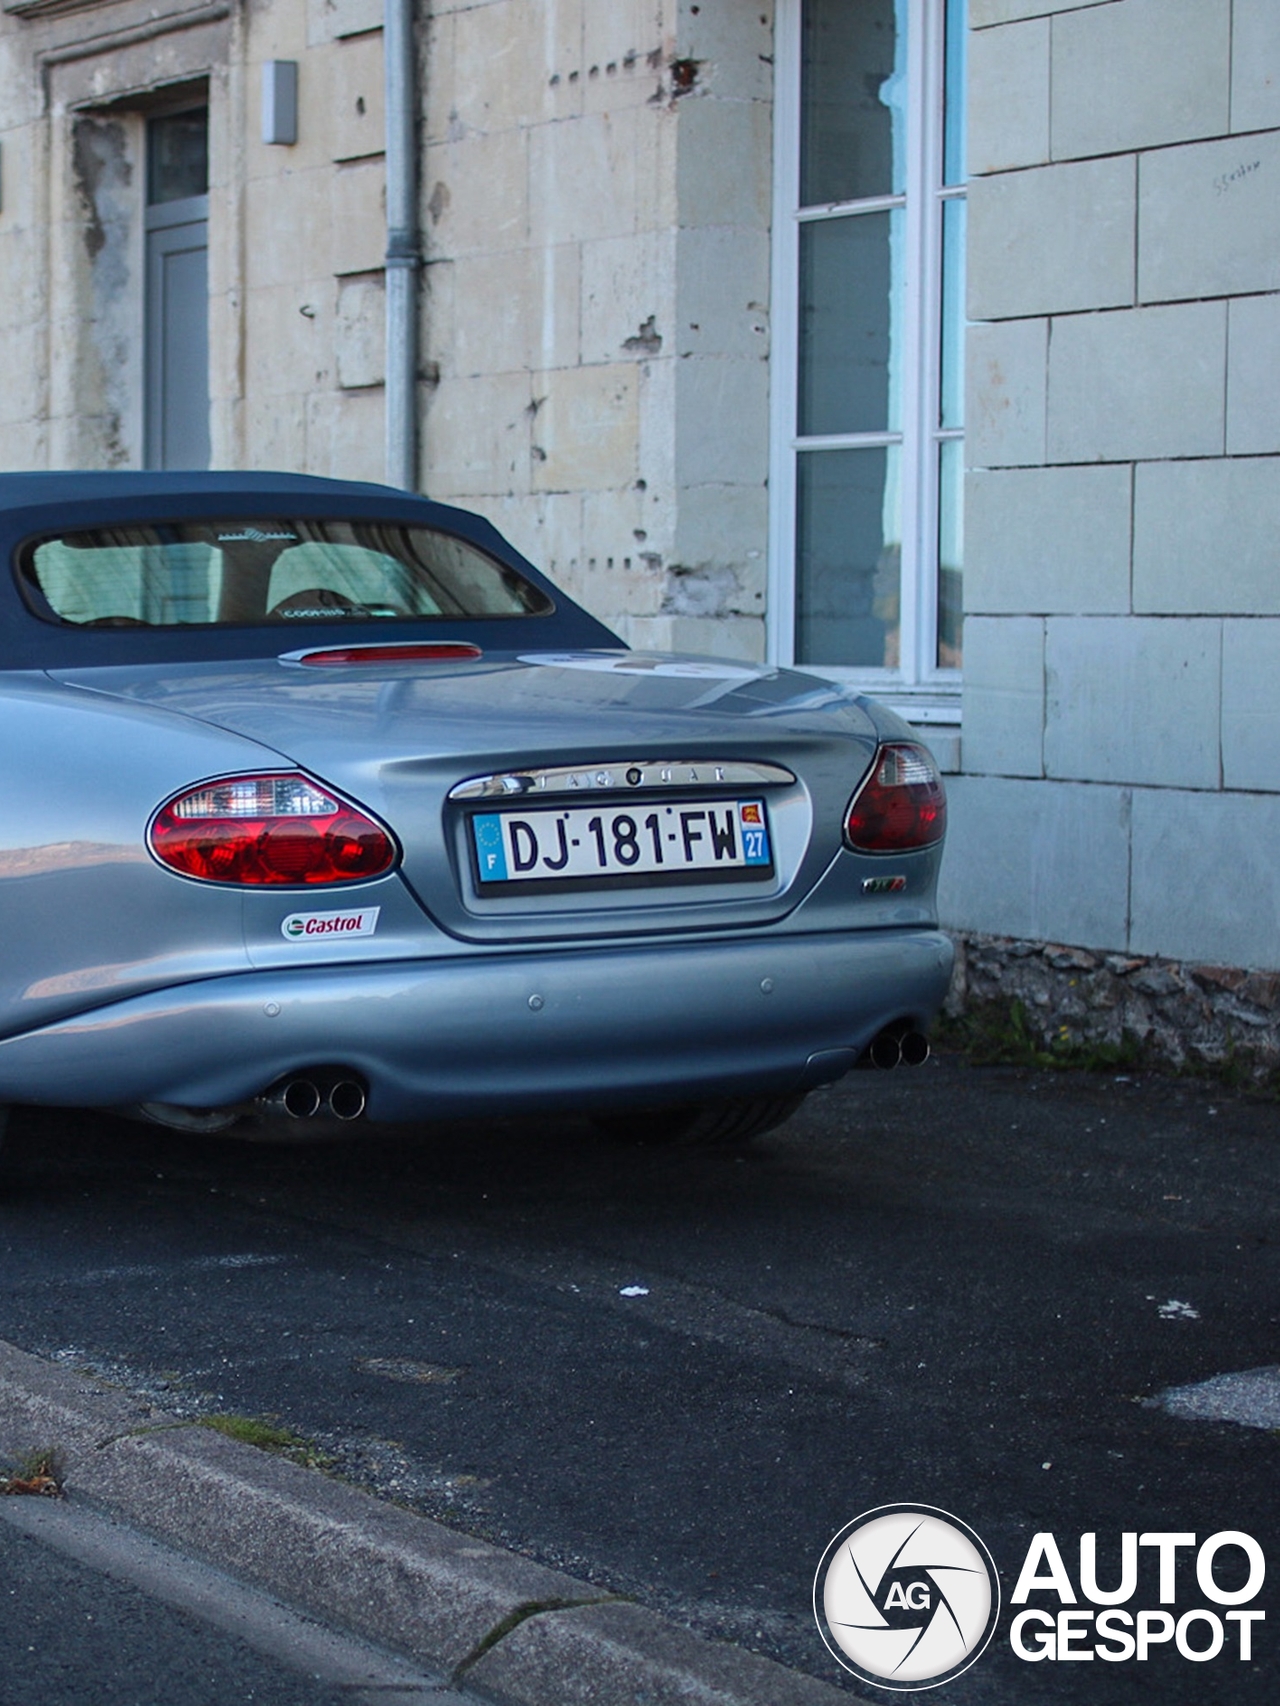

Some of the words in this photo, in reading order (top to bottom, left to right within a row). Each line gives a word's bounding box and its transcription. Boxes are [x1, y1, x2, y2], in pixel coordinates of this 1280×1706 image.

[538, 766, 726, 789] JAGUAR
[745, 832, 764, 858] 27
[486, 853, 497, 870] F
[305, 914, 363, 935] Castrol
